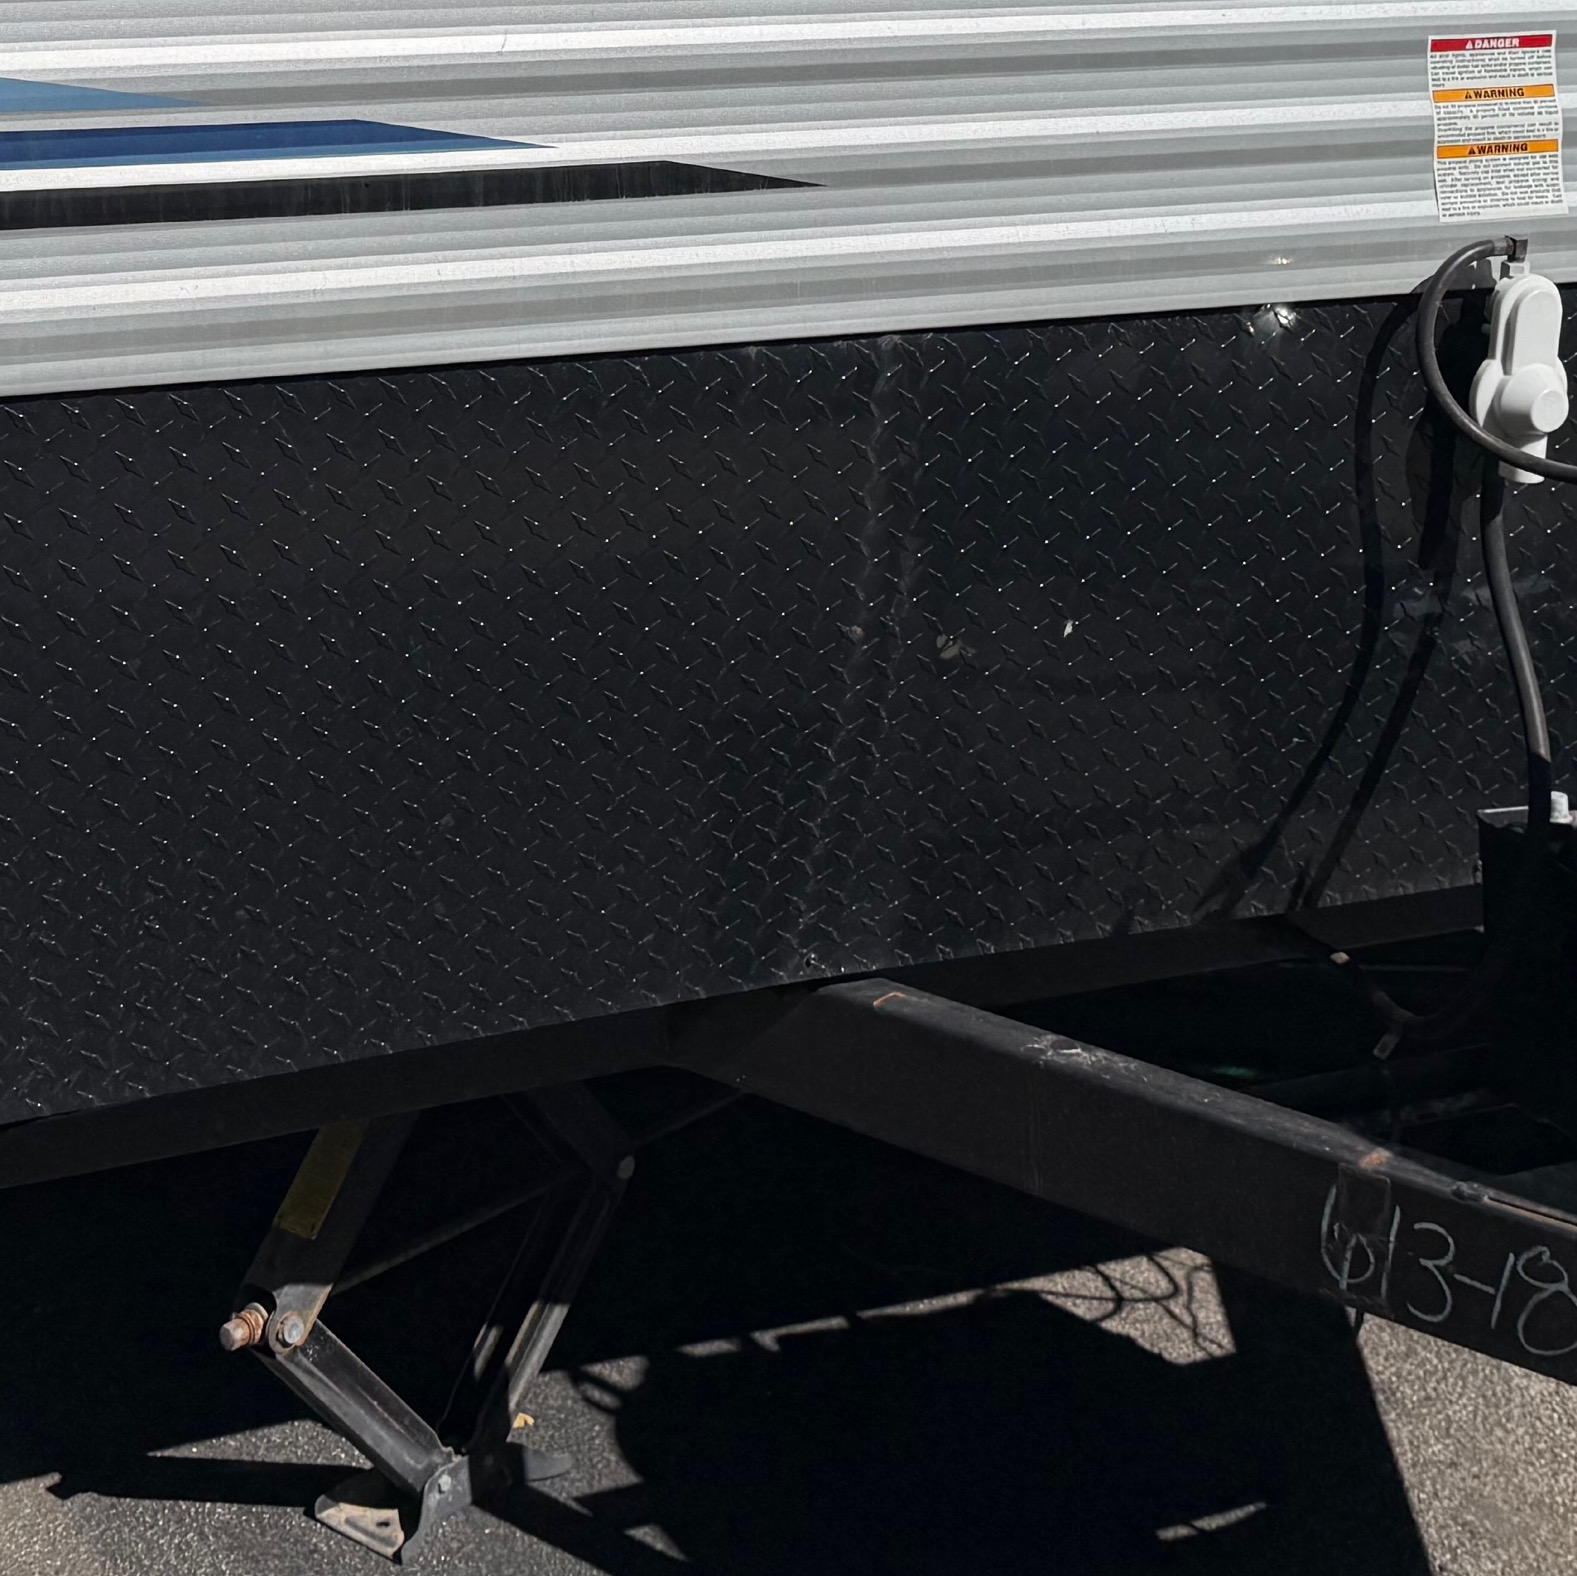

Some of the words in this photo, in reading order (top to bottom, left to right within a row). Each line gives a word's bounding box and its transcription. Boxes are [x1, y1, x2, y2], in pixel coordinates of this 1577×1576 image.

[1474, 38, 1520, 50] DANGER
[1473, 87, 1525, 100] WARNING
[1476, 142, 1528, 155] WARNING
